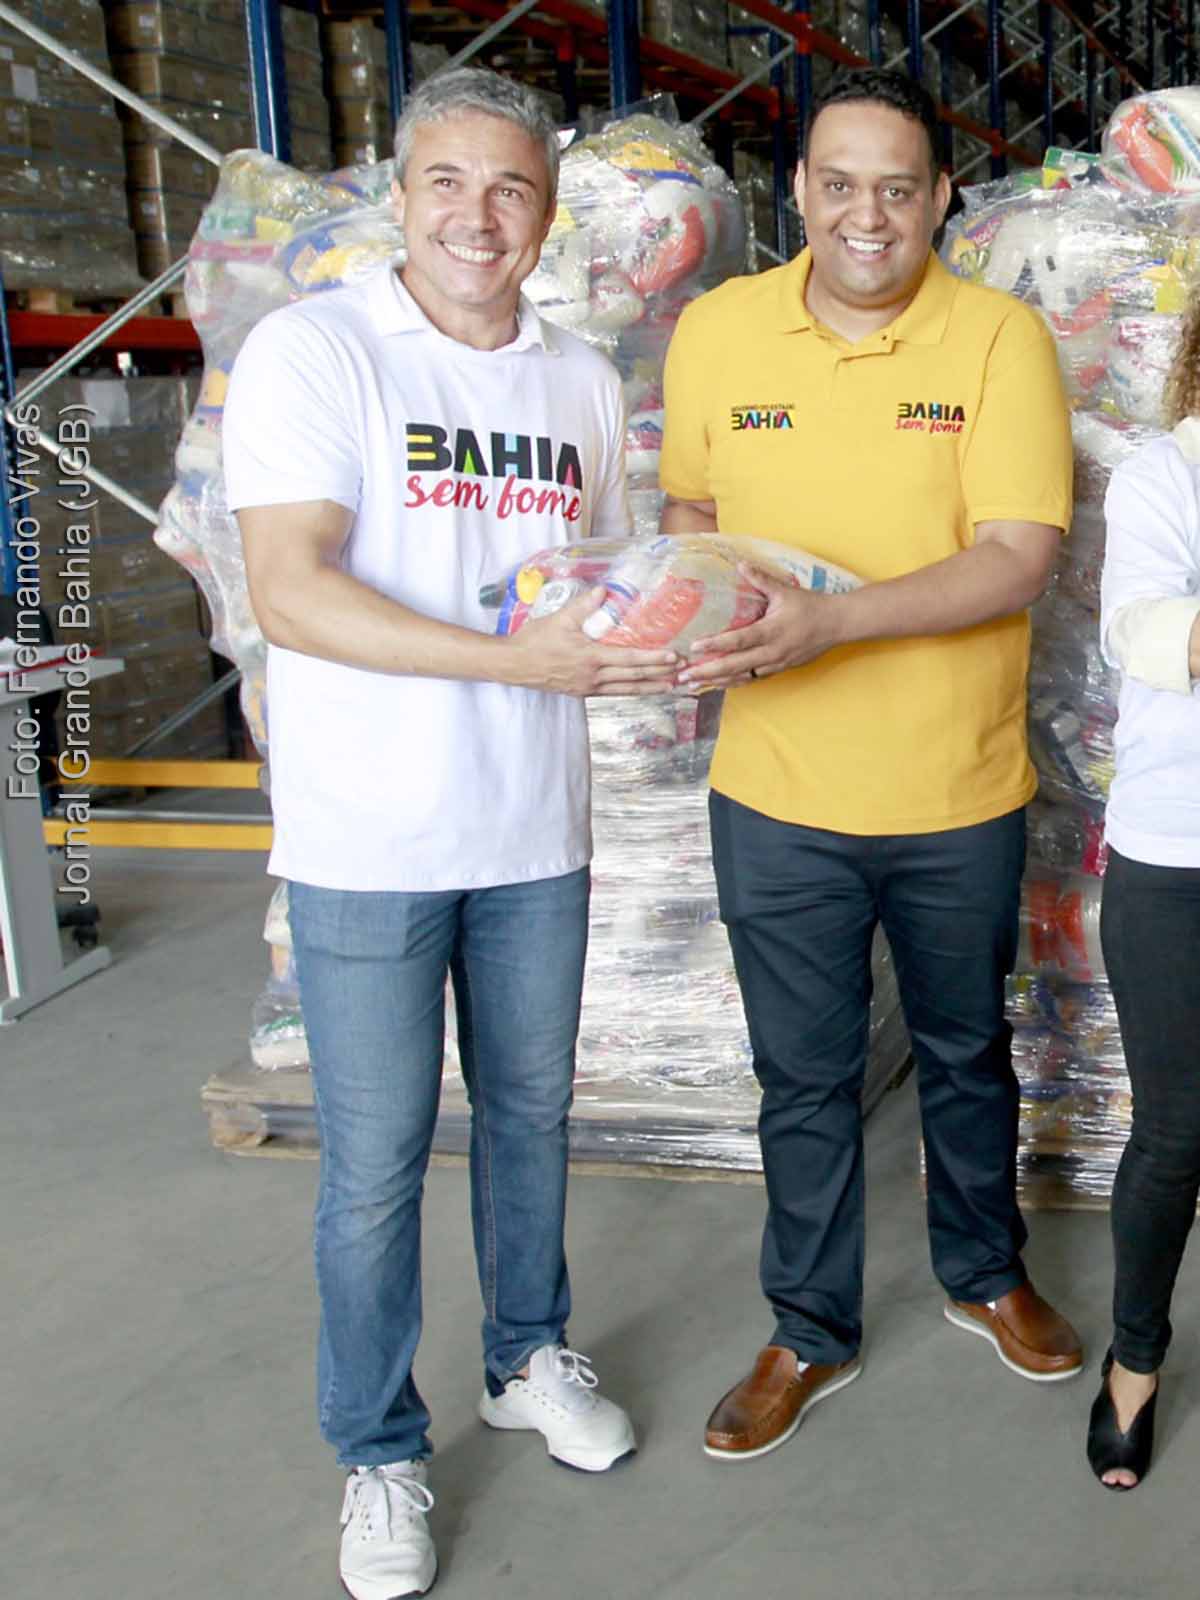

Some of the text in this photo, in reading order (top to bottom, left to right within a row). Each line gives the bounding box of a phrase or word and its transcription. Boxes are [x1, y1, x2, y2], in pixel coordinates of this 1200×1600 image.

[896, 402, 965, 421] BAHIA
[405, 422, 583, 490] BAHIA
[404, 473, 582, 522] sem fome
